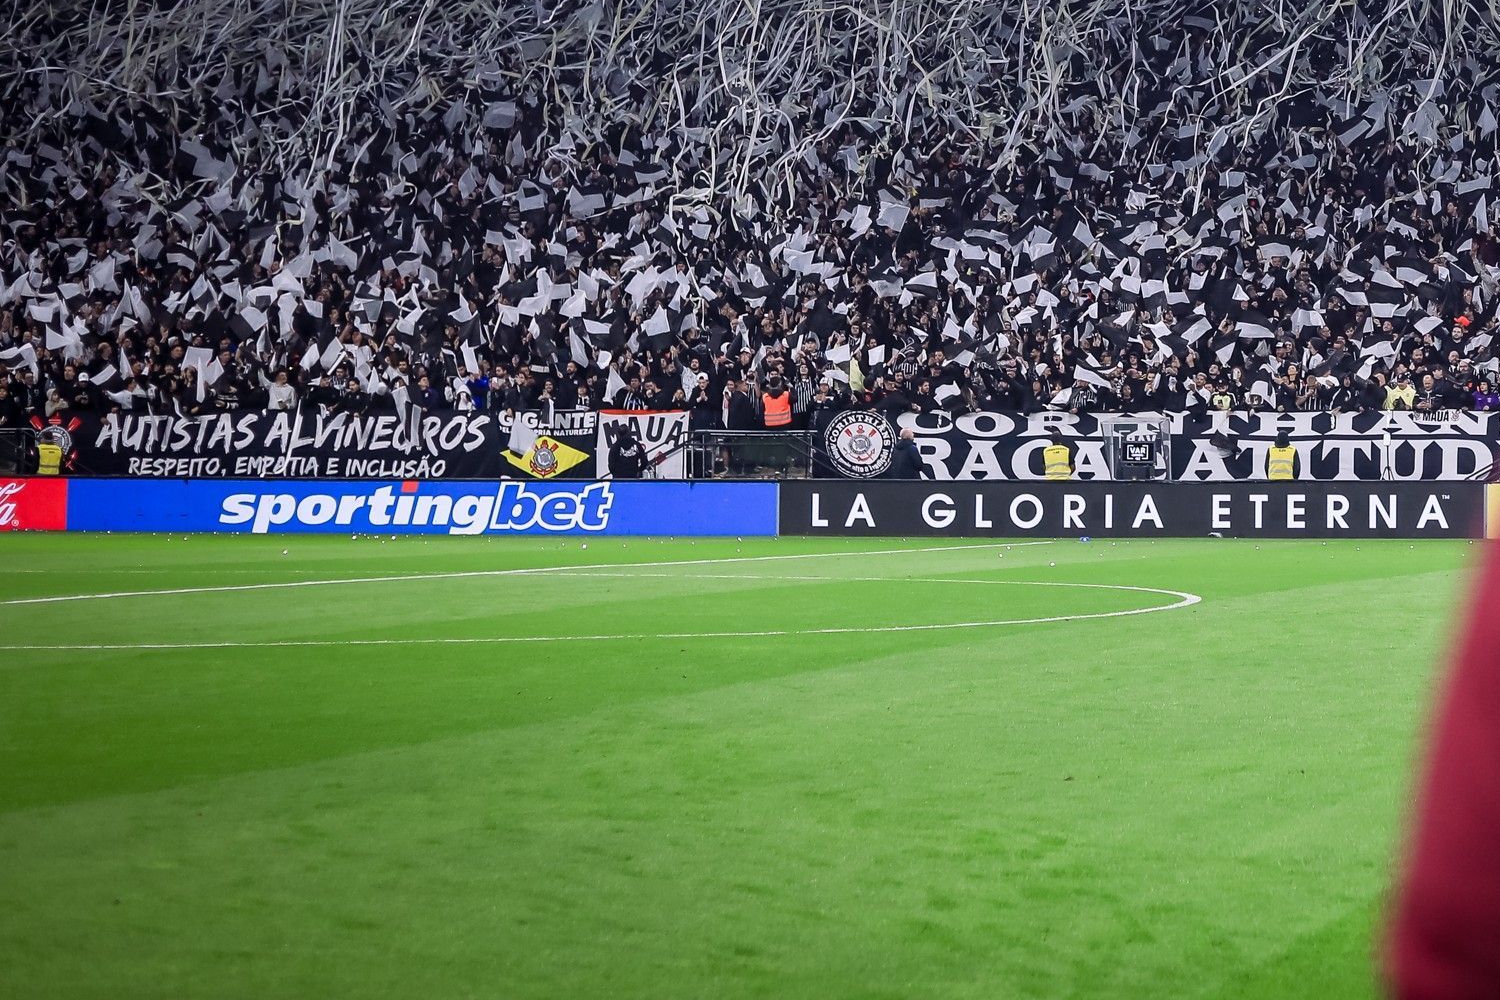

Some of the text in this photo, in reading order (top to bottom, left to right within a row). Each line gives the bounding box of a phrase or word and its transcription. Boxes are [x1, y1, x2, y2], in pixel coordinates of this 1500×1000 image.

[95, 412, 258, 454] AUTISTAS
[554, 428, 594, 437] NATUREZA
[829, 414, 891, 447] CORINTHIANS
[129, 455, 447, 478] RESPEITO, EMPATIA E INCLUSÃO
[1129, 446, 1146, 454] VAR
[218, 480, 616, 536] sportingbet
[811, 493, 876, 527] LA
[921, 493, 1164, 529] GLORIA
